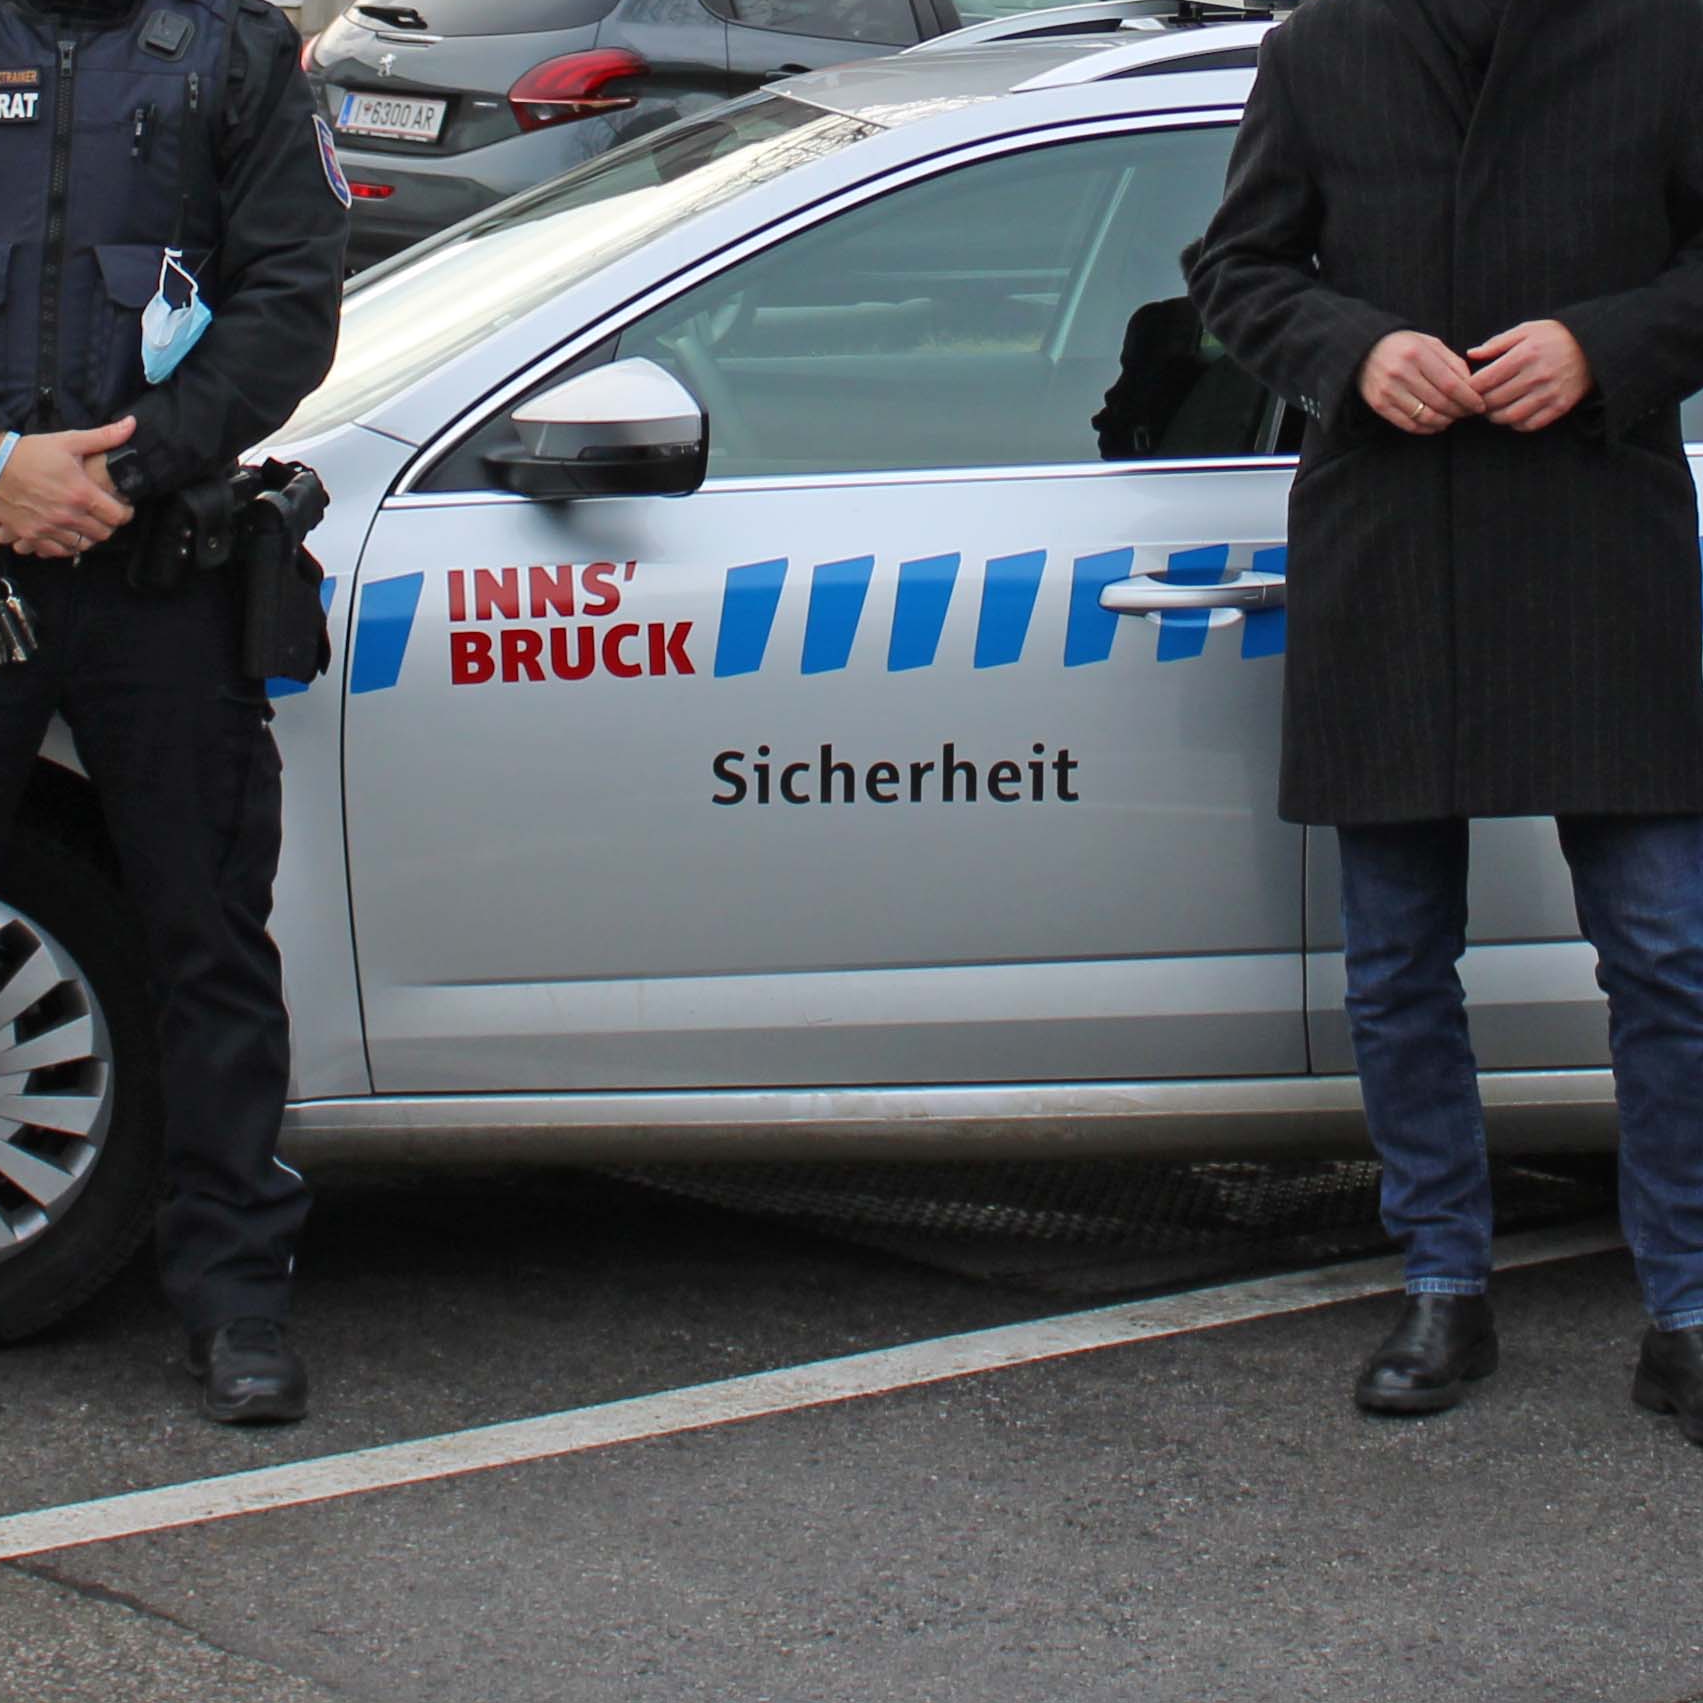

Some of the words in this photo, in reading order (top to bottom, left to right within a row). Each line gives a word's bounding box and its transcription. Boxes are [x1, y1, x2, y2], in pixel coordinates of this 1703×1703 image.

[354, 100, 363, 123] I
[370, 102, 412, 127] 6300
[412, 107, 436, 131] AR
[450, 621, 696, 685] BRUCK
[712, 742, 1080, 805] Sicherheit
